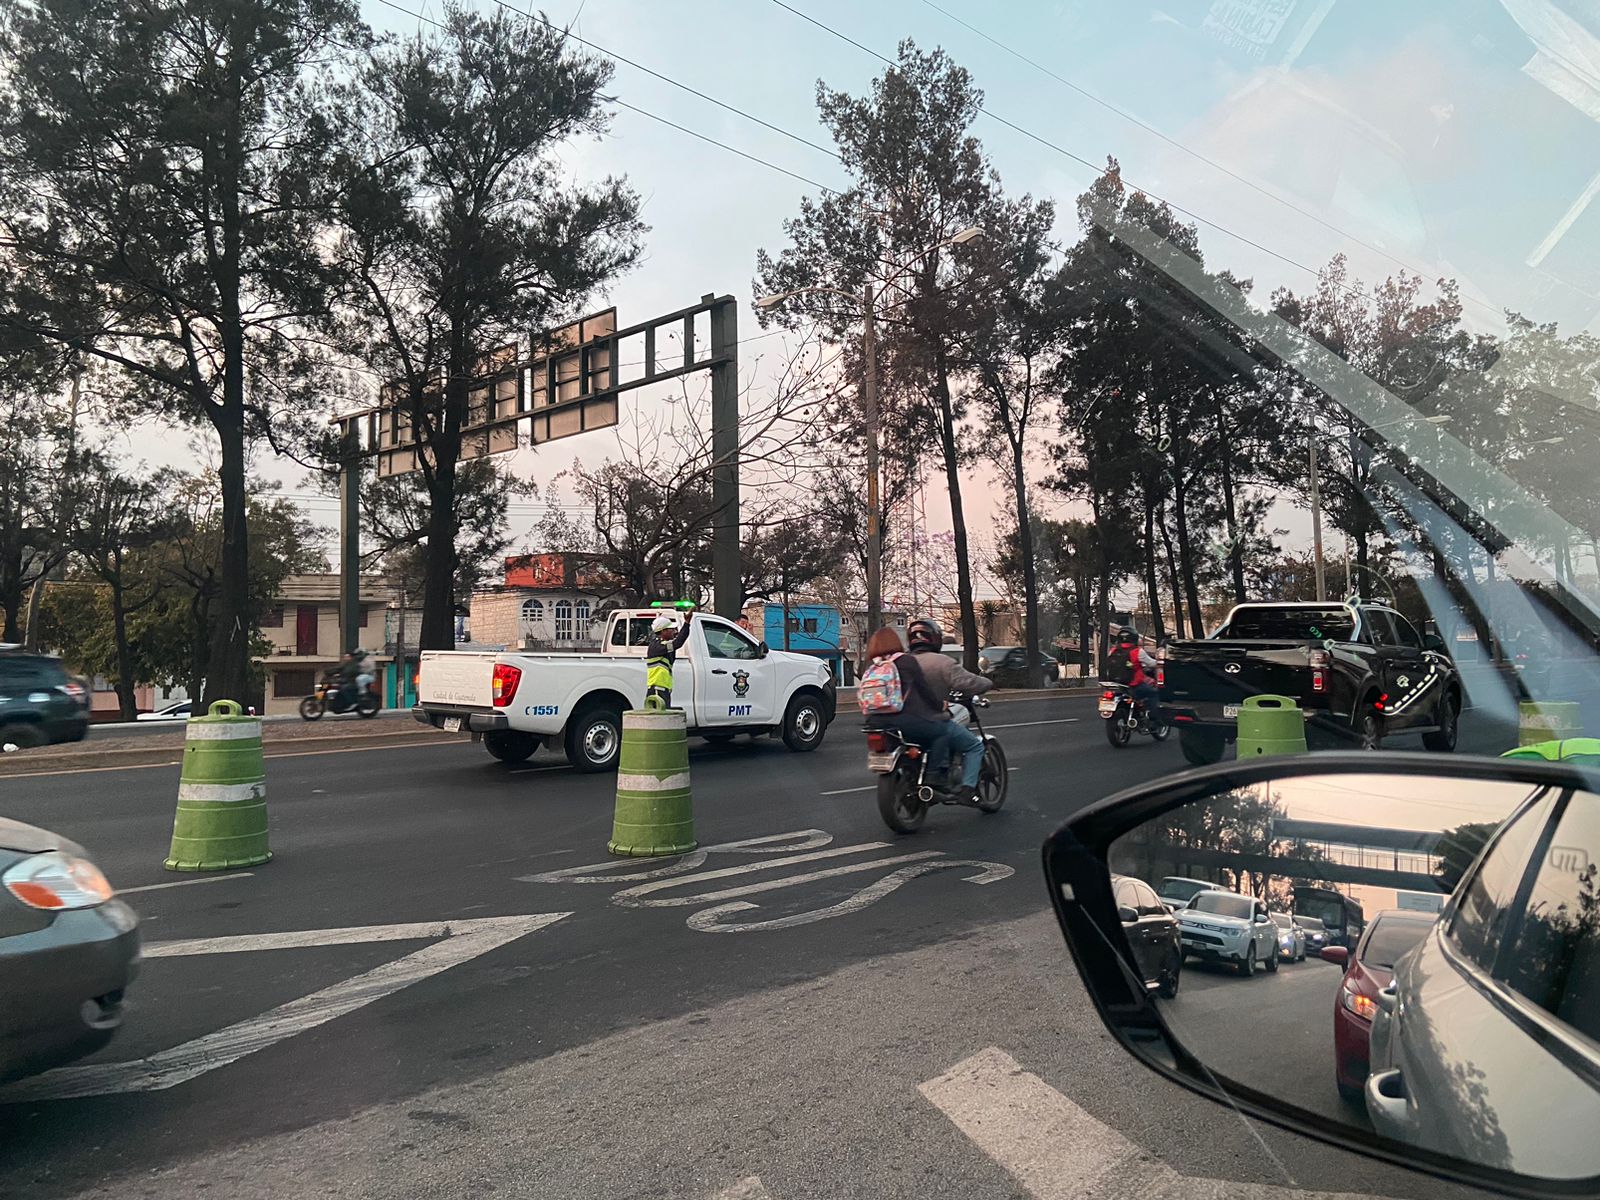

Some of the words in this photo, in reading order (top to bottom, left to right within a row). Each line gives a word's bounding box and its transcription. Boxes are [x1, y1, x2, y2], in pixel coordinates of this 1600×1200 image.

[532, 705, 559, 716] 1551
[728, 705, 752, 716] PMT
[514, 828, 1016, 933] BUS
